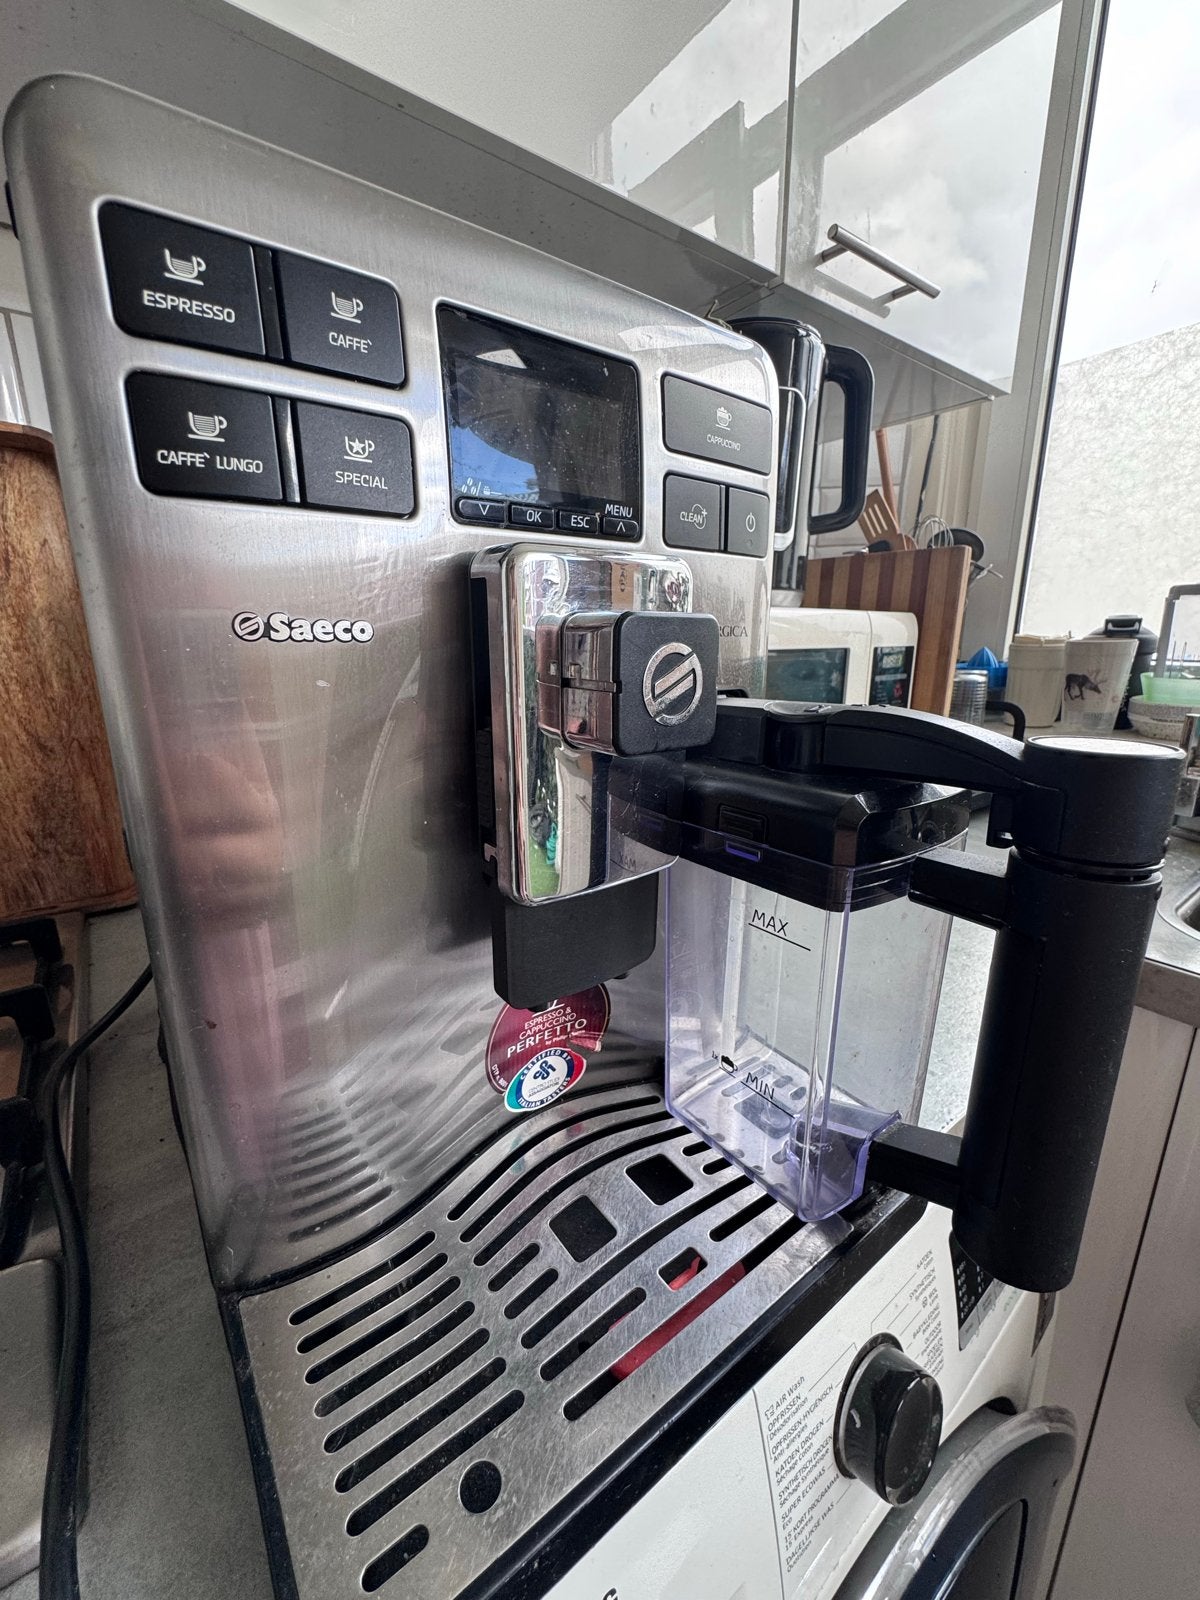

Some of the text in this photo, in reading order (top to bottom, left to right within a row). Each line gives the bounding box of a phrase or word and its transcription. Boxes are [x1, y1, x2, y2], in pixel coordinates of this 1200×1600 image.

[142, 289, 236, 324] ESPRESSO
[706, 433, 741, 451] CAPPUCCINO
[215, 454, 264, 474] LUNGO
[334, 470, 389, 490] SPECIAL
[526, 510, 542, 523] OK
[570, 516, 591, 529] ESC
[604, 503, 634, 519] MENU
[267, 611, 374, 643] Saeco
[751, 909, 789, 937] MAX
[519, 1012, 577, 1040] CAPPUCCINO
[524, 1006, 572, 1030] ESPRESSO &
[507, 1018, 587, 1058] PERFETTO
[520, 1049, 562, 1080] CERTIFIED
[517, 1077, 571, 1108] ITALIAN TASTERS
[745, 1072, 775, 1100] MIN
[775, 1376, 805, 1410] AIR Wash
[767, 1392, 801, 1432] OPFRISSEN
[771, 1418, 802, 1455] OPFRISSEN
[775, 1418, 824, 1478] KATOEN DROGEN
[781, 1465, 826, 1523] SUPER ECOWAS
[792, 1511, 807, 1533] KORT
[821, 1501, 835, 1521] WAS
